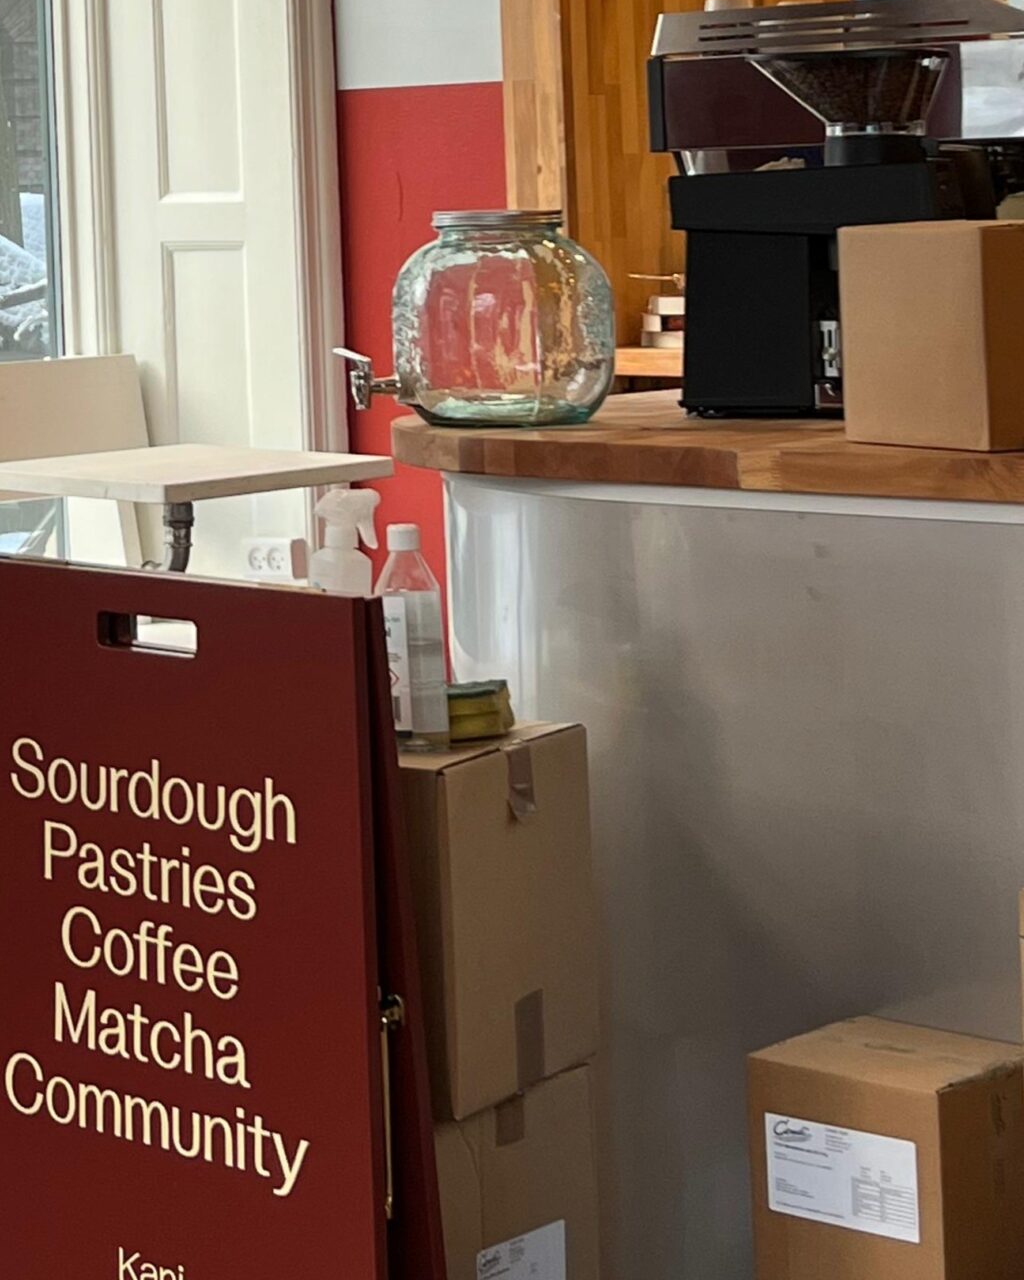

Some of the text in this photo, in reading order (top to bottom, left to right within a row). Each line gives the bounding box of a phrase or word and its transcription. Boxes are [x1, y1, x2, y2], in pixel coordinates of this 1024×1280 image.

[10, 737, 297, 853] Sourdough
[43, 820, 257, 921] Pastries
[61, 906, 239, 1000] Coffee
[54, 981, 252, 1089] Matcha
[4, 1052, 310, 1197] Community
